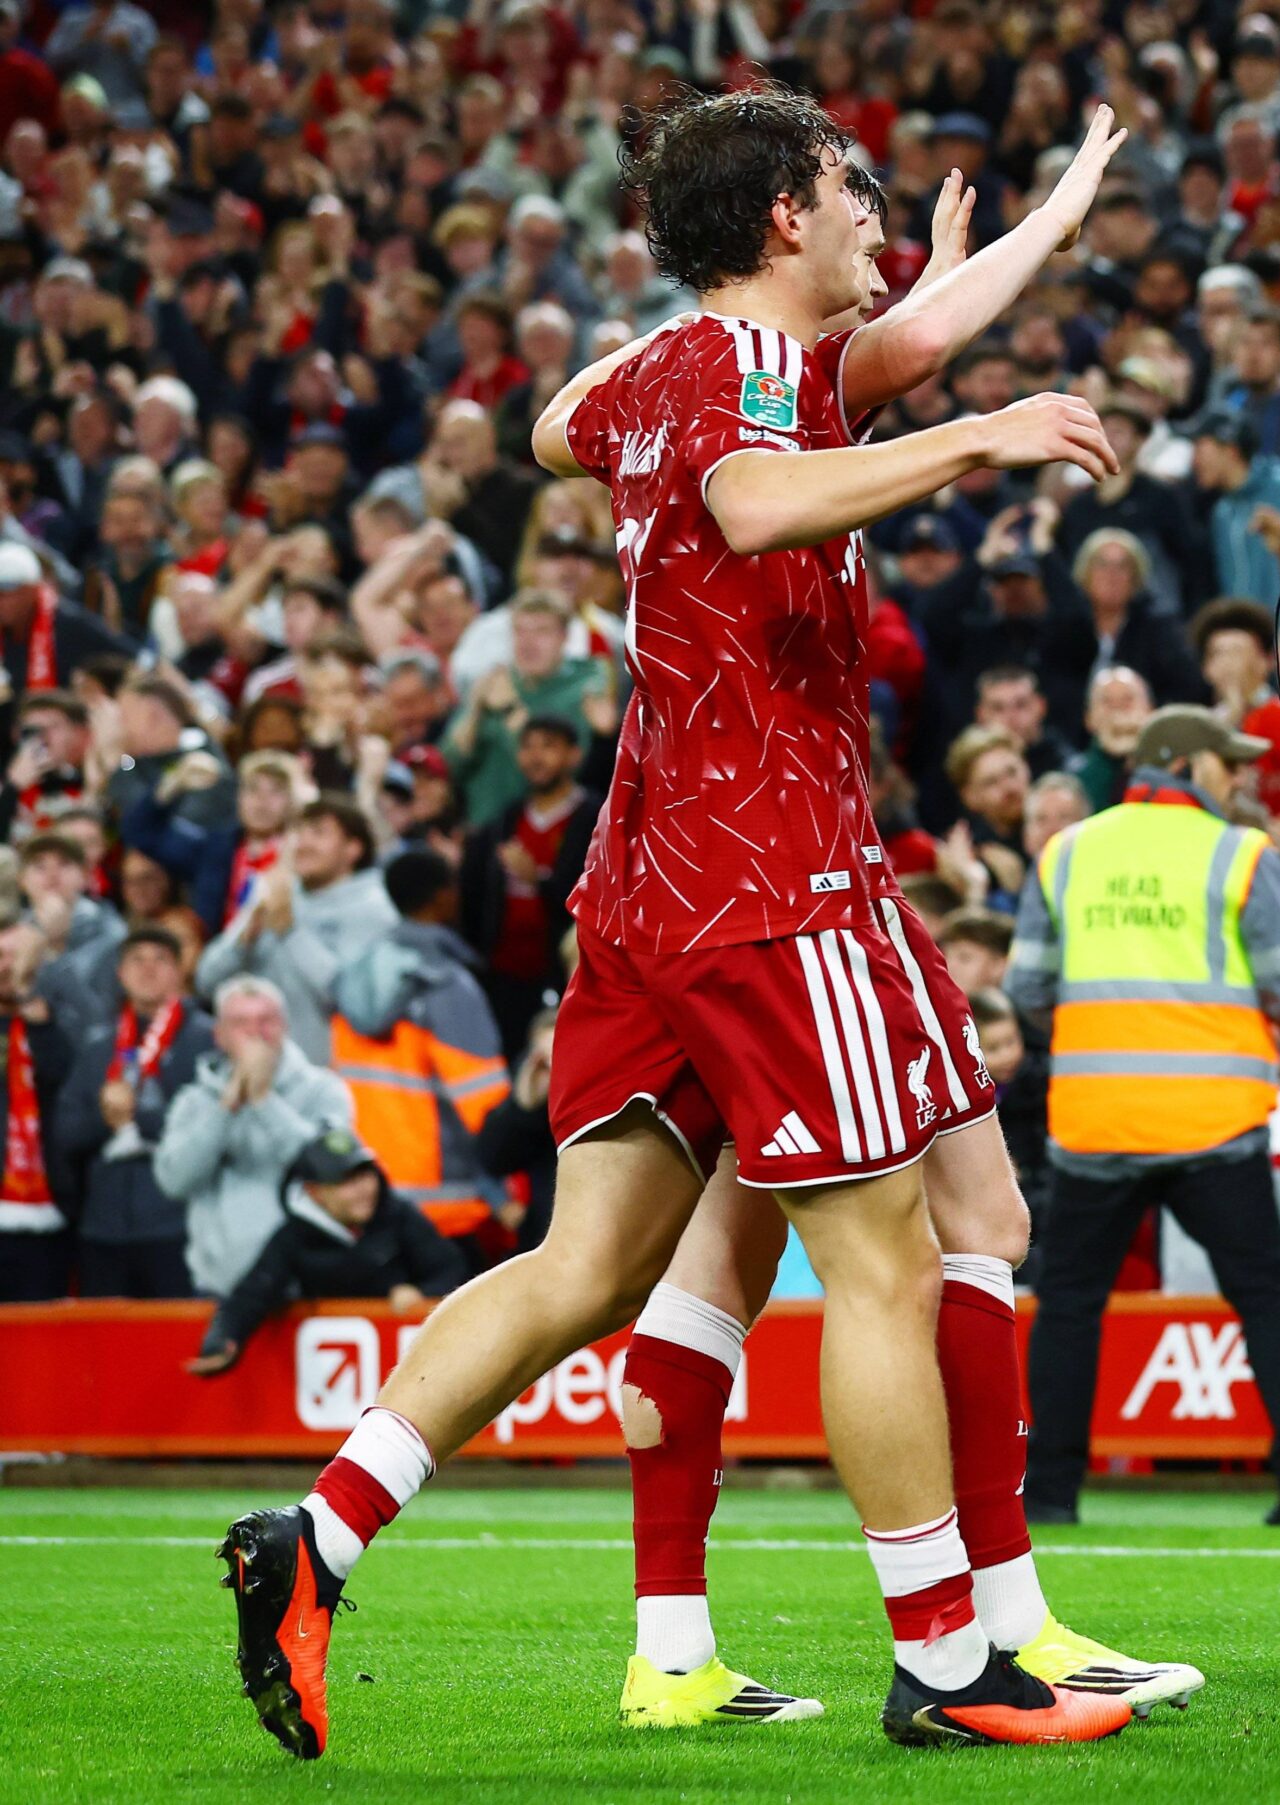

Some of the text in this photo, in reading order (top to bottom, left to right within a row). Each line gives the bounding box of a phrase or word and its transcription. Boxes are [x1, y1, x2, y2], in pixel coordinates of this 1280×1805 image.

[1103, 876, 1162, 898] HEAD
[1083, 902, 1187, 929] STEWARD
[916, 1105, 938, 1131] LFC
